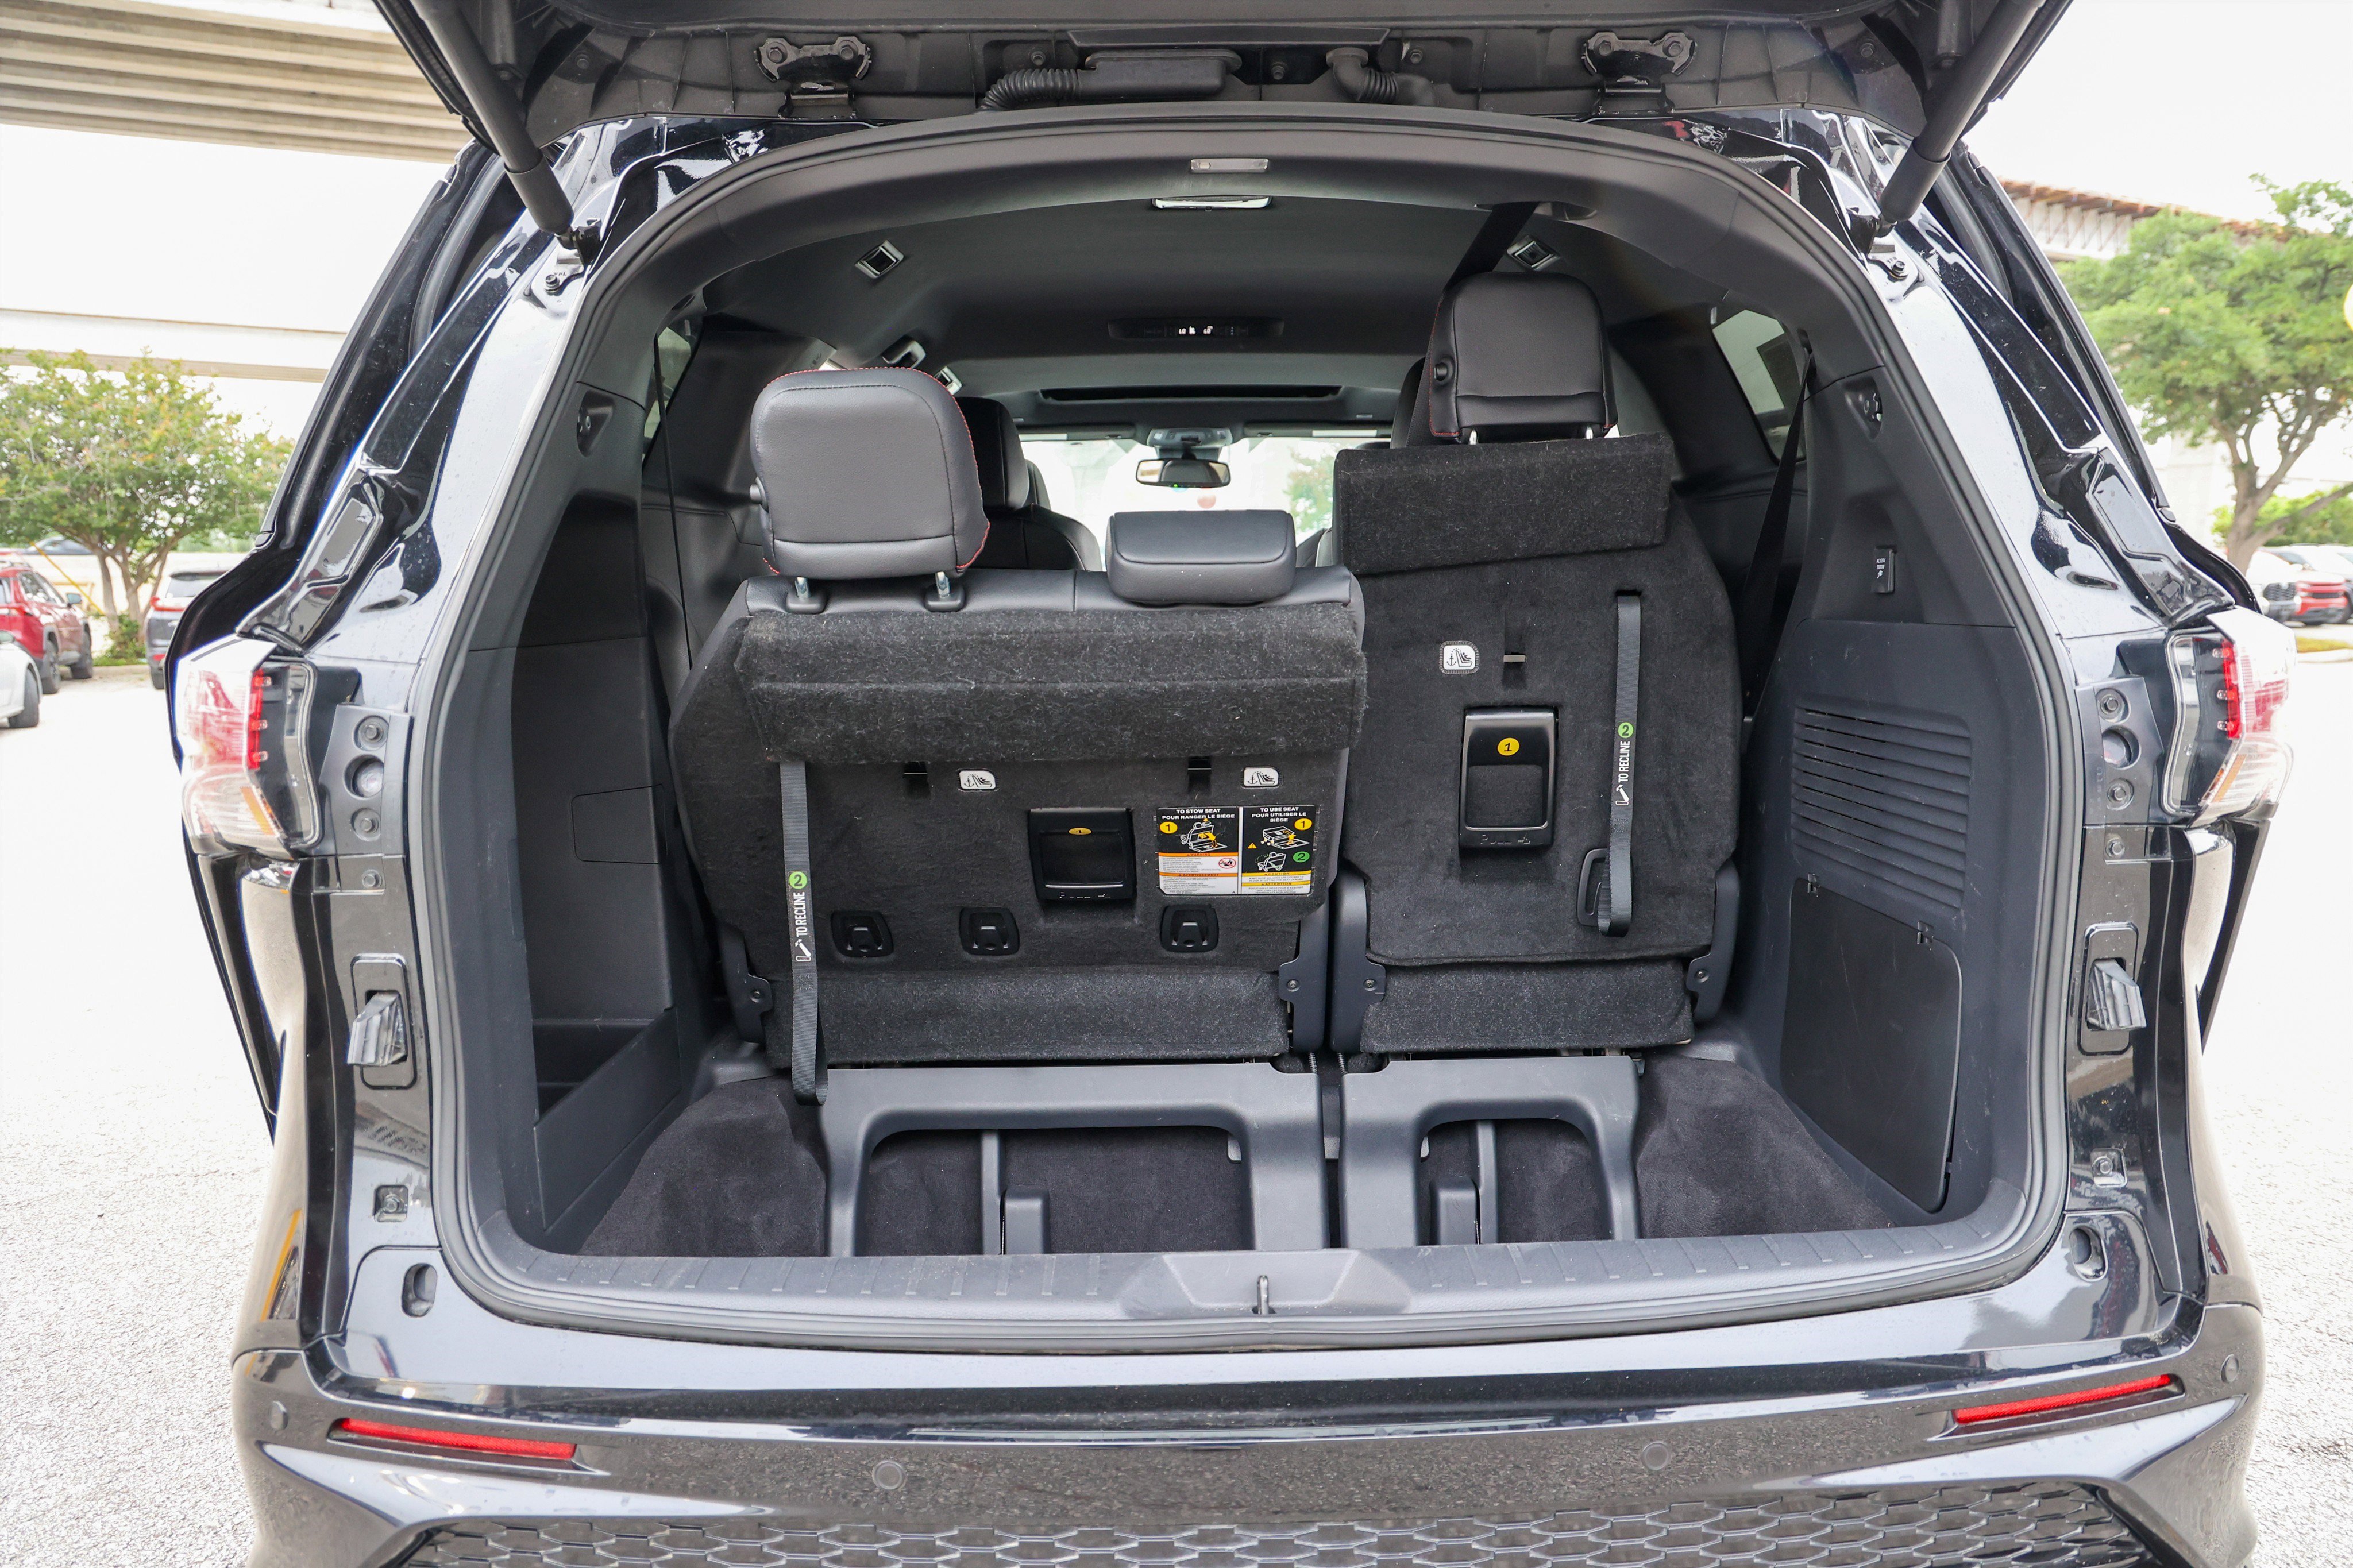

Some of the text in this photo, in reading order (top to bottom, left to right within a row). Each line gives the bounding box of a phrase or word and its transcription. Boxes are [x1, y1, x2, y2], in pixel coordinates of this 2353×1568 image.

[1622, 724, 1630, 736] 2
[1504, 743, 1512, 752] 1
[1618, 741, 1630, 783] TO RECLINE
[1166, 824, 1171, 832] 1
[794, 874, 803, 886] 2
[794, 892, 808, 937] TO RECLINE
